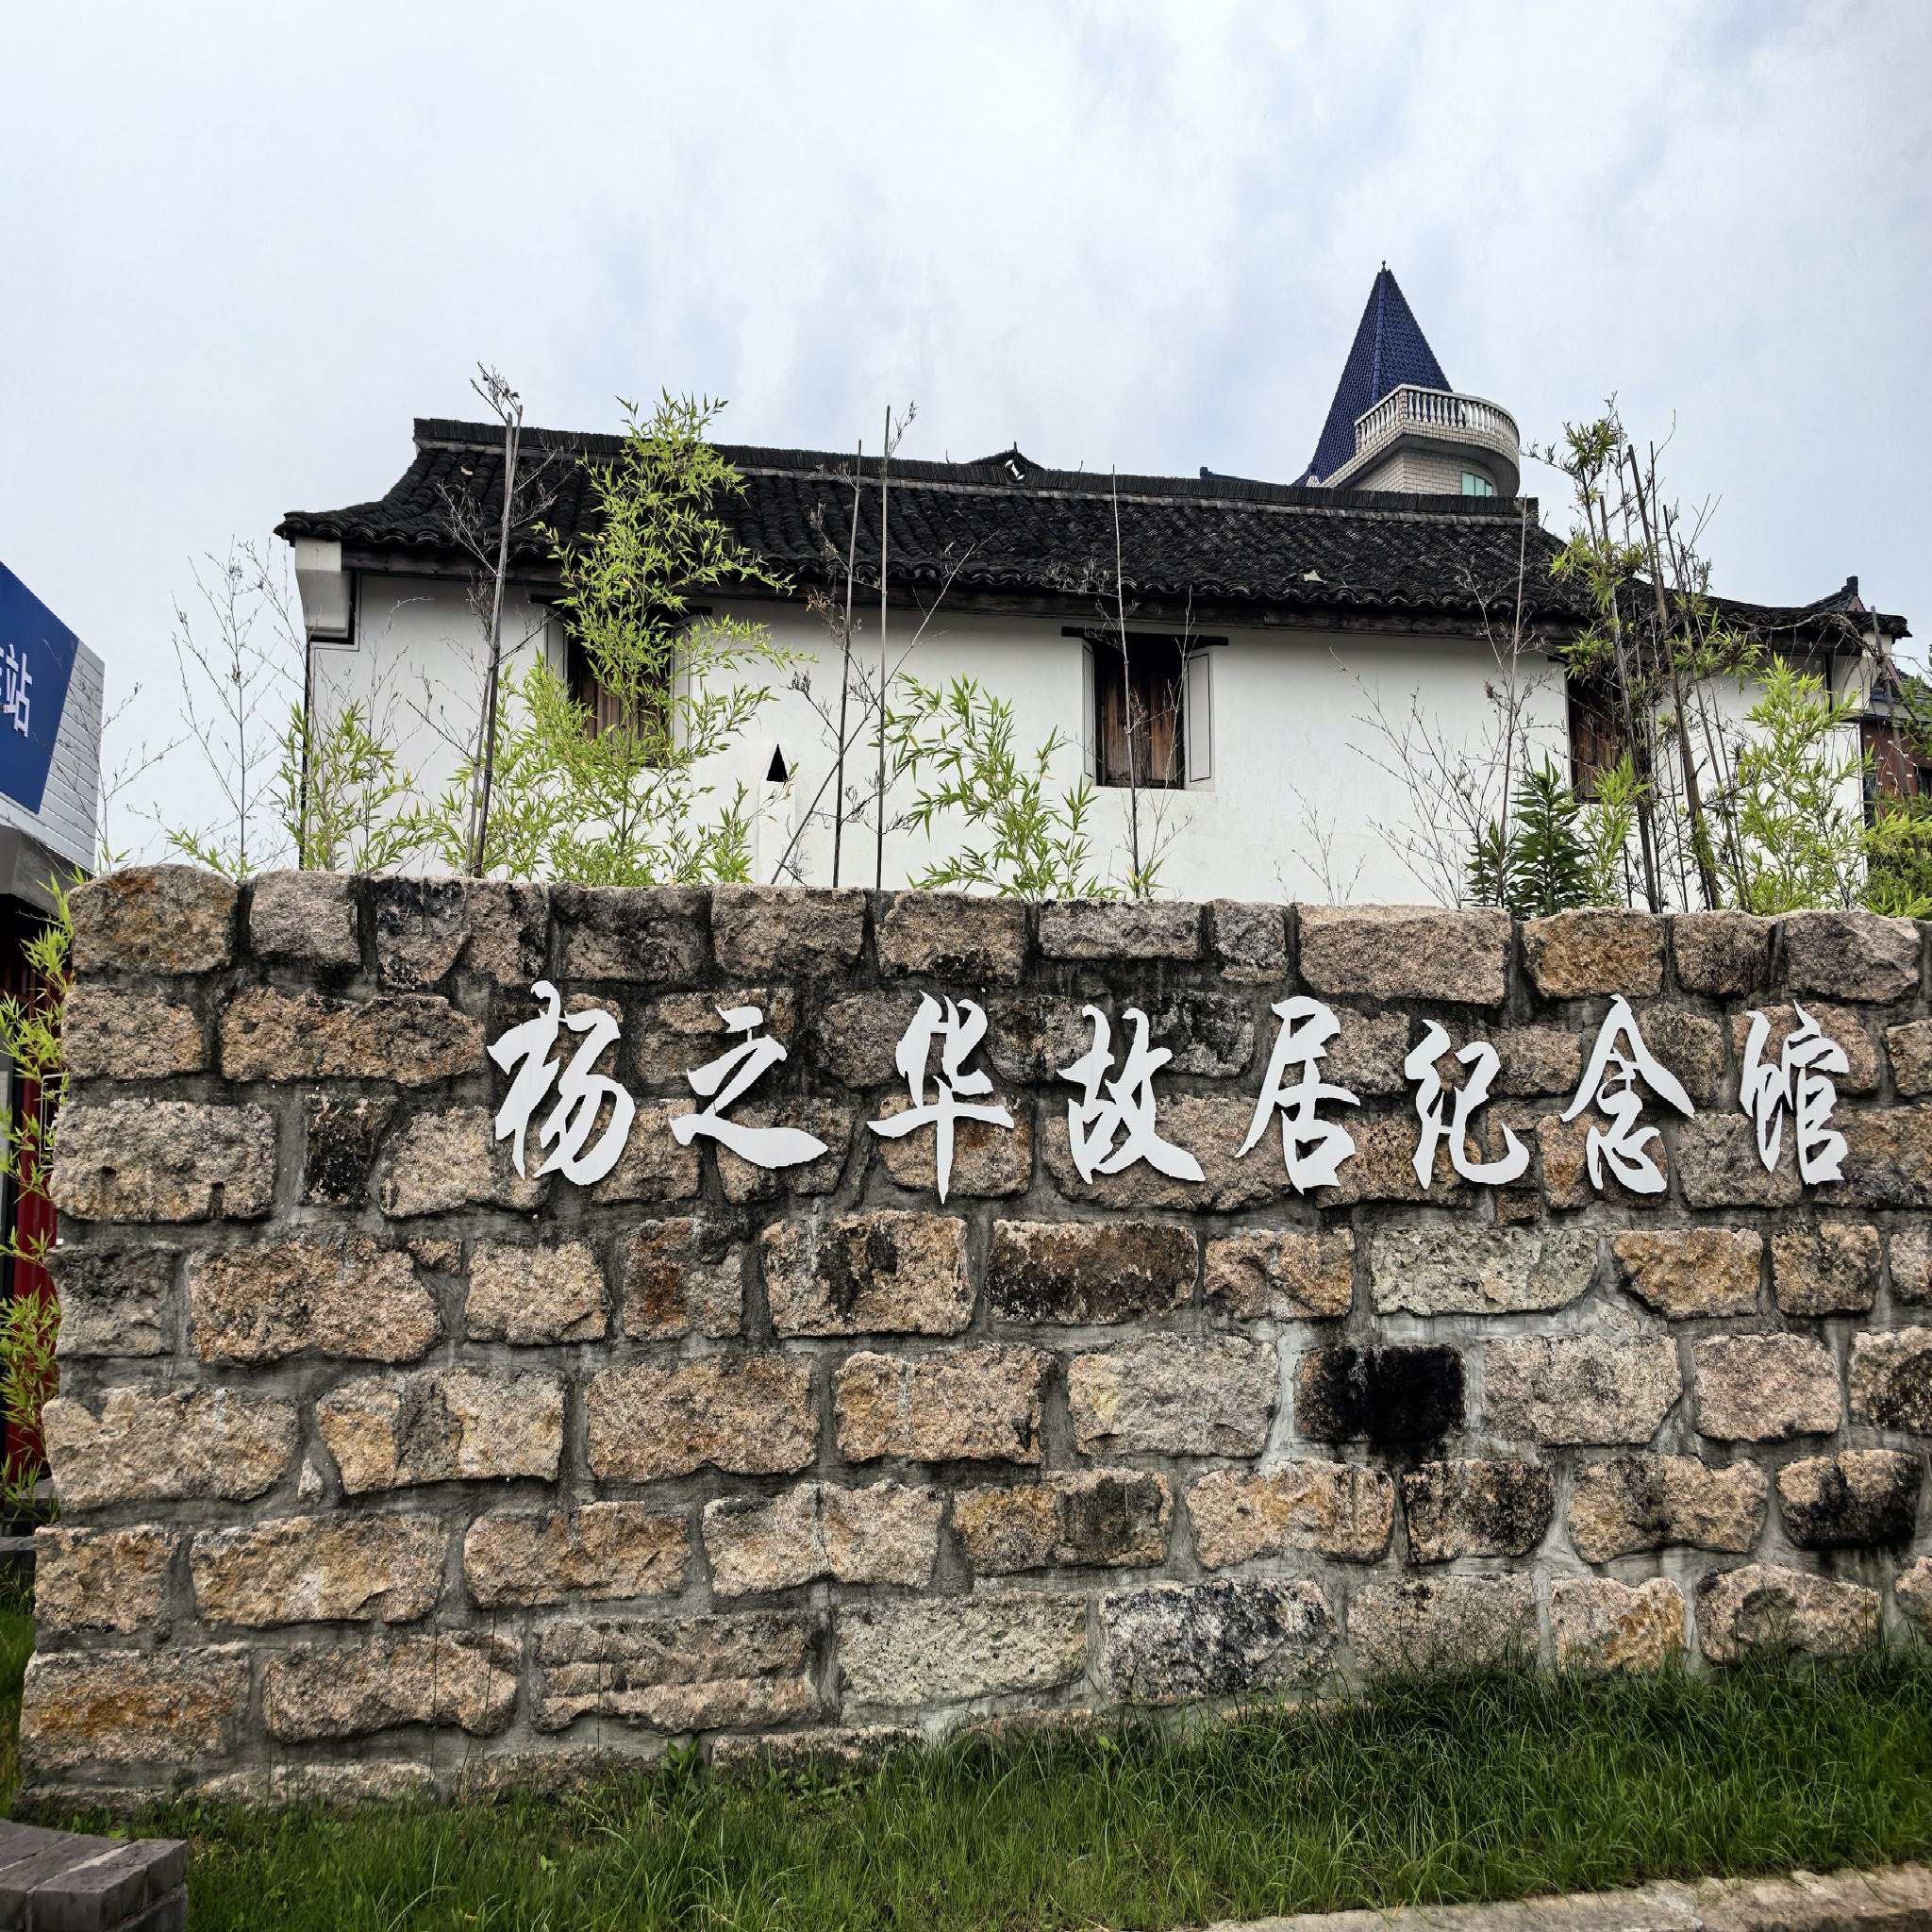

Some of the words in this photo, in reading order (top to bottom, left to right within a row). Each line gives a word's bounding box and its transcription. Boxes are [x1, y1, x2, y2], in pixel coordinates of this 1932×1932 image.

[486, 980, 1850, 1205] 杨之华故居纪念馆
